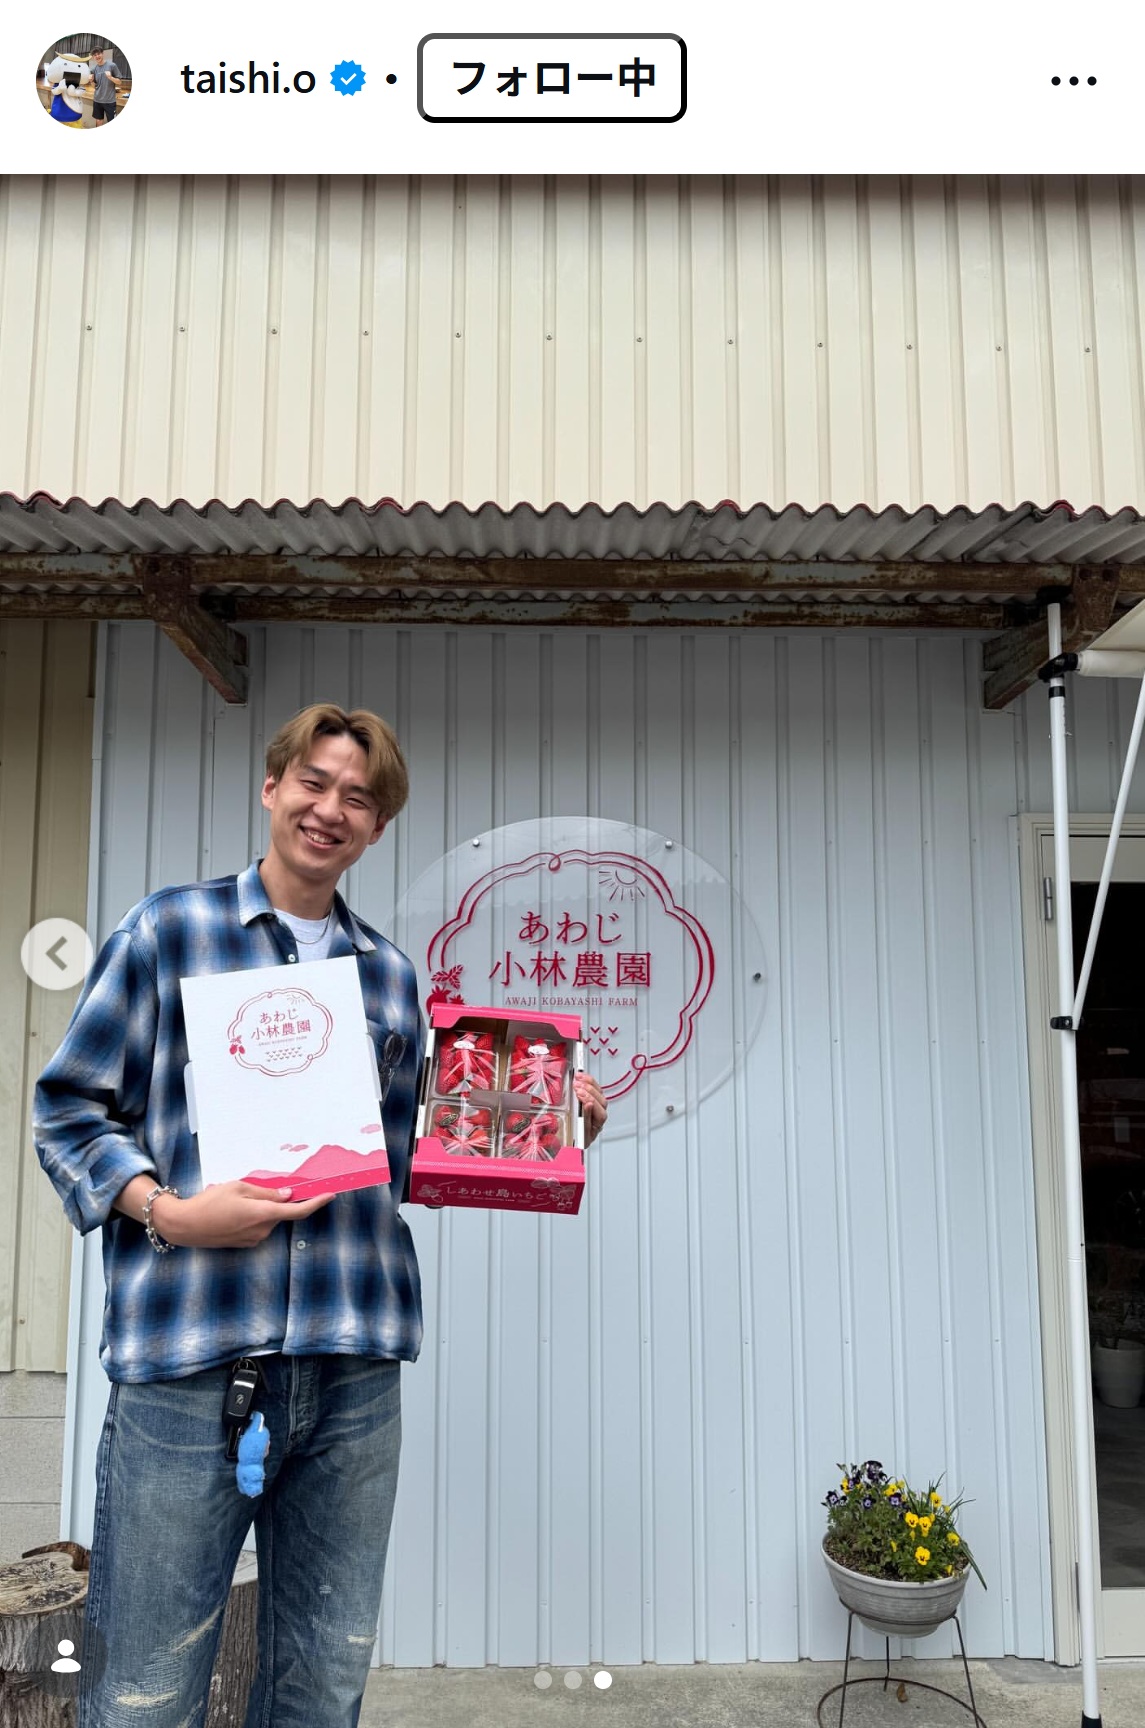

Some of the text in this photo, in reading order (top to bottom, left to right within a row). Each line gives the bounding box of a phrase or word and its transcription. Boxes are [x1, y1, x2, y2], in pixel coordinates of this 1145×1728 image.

[518, 911, 623, 945] あわじ
[488, 950, 653, 989] 小林農園
[505, 996, 638, 1007] AWAJI KOBAYASHI FARM
[260, 1008, 299, 1025] あわじ
[250, 1019, 311, 1041] 小林農園
